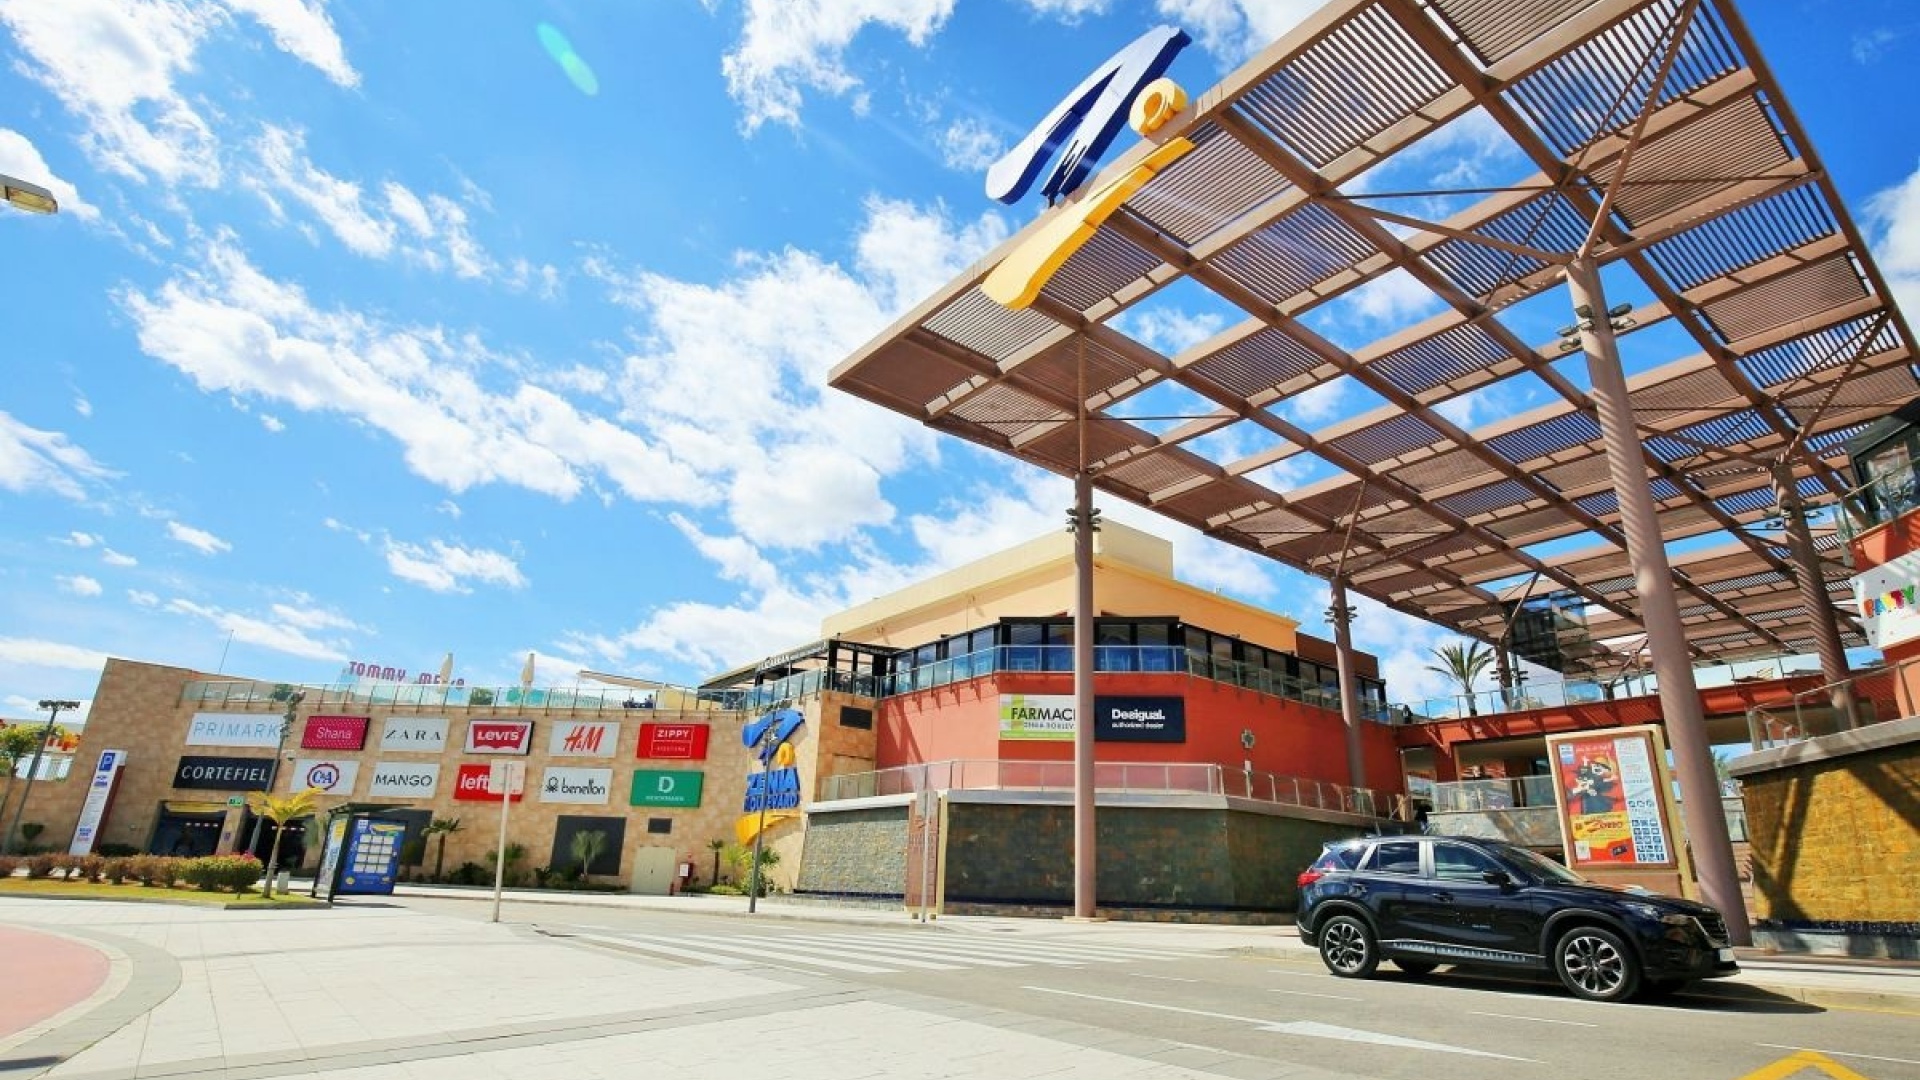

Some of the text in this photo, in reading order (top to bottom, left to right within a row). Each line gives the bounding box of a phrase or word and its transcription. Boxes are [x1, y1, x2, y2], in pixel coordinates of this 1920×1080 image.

[348, 661, 406, 682] TOMMY
[1011, 707, 1076, 721] FARMACI
[193, 721, 279, 738] PRIMARK
[317, 726, 352, 740] Shana
[385, 729, 441, 741] ZARA
[656, 729, 689, 738] ZIPPY
[564, 725, 605, 753] H&M
[181, 765, 267, 781] CORTEFIEL
[312, 769, 332, 784] C&A
[375, 774, 433, 787] MANGO
[561, 777, 606, 795] benetton
[658, 776, 675, 793] D
